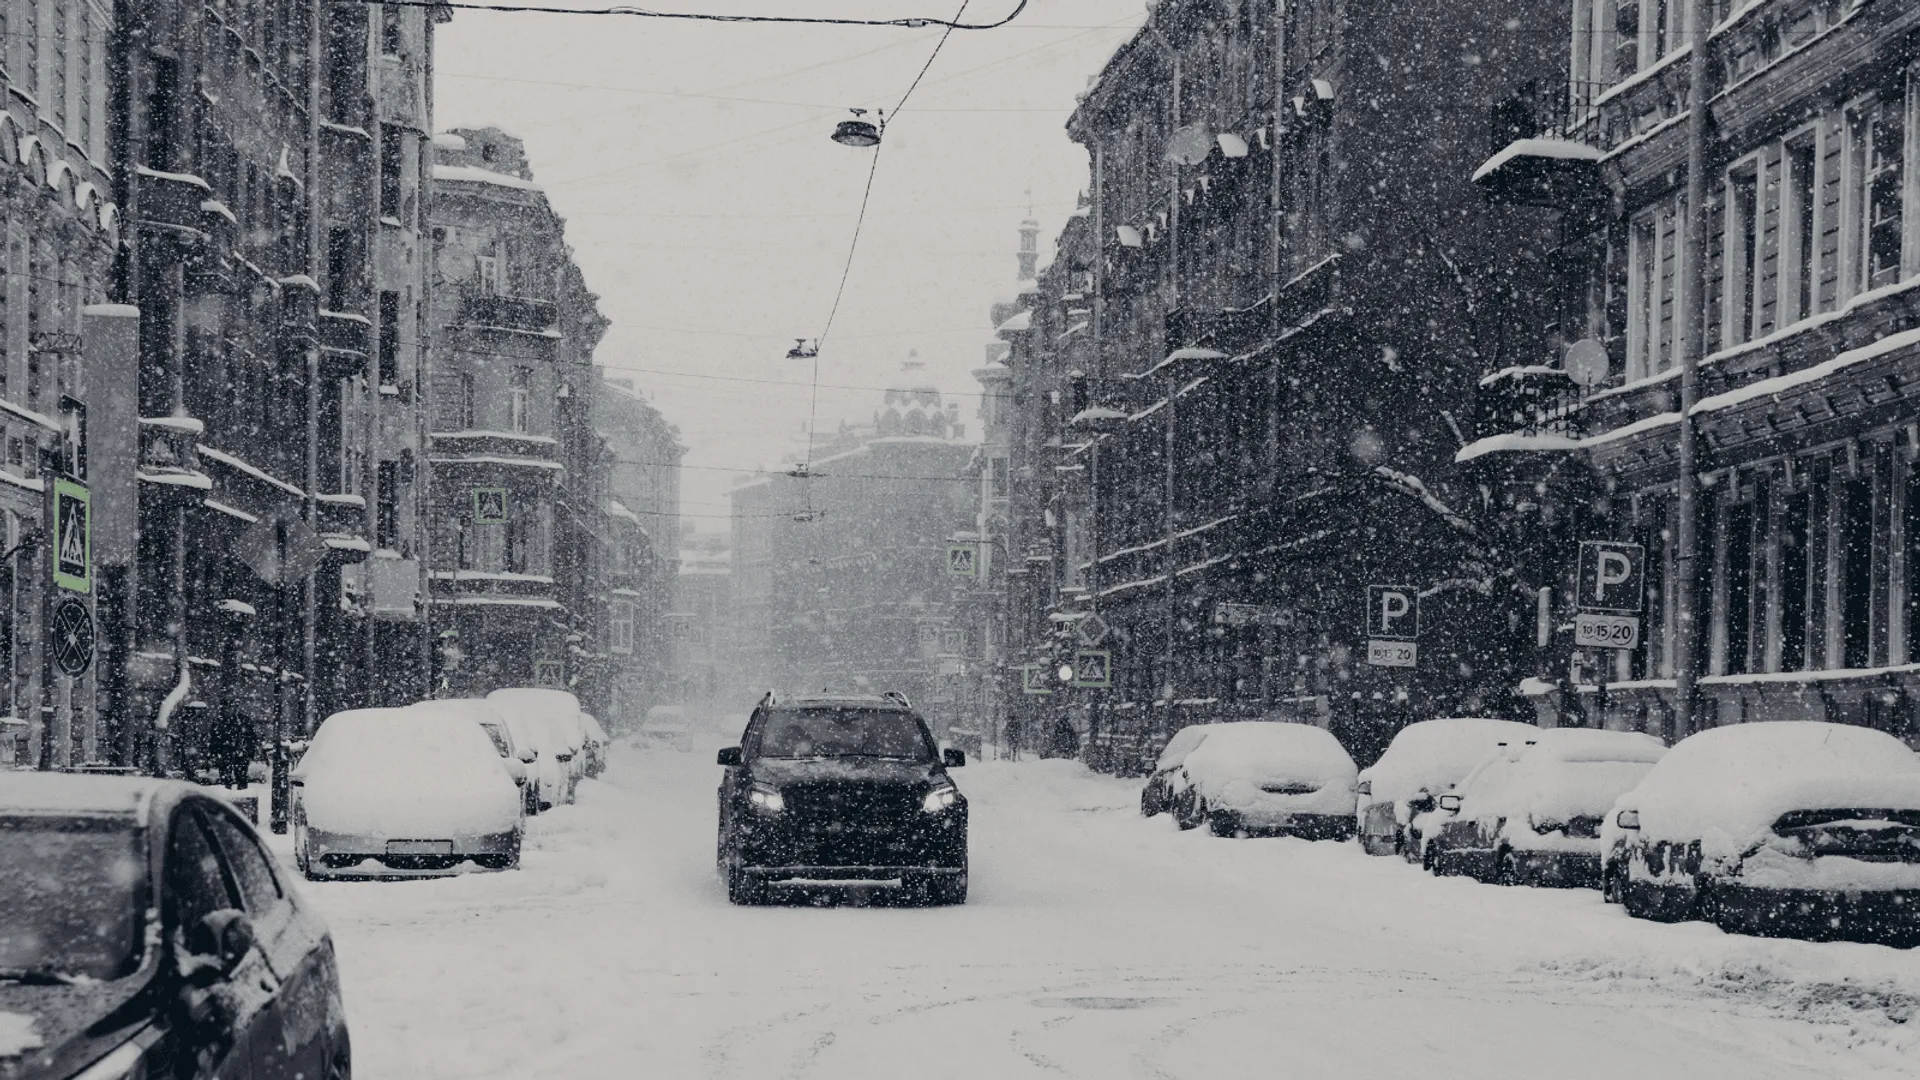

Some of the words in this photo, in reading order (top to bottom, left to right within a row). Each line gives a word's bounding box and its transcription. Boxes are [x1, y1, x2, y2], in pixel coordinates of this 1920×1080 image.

[1596, 551, 1631, 601] P
[1382, 591, 1409, 632] P
[1582, 625, 1593, 635] 10
[1596, 625, 1608, 637] 15
[1611, 625, 1631, 639] 20
[1396, 648, 1412, 660] 20
